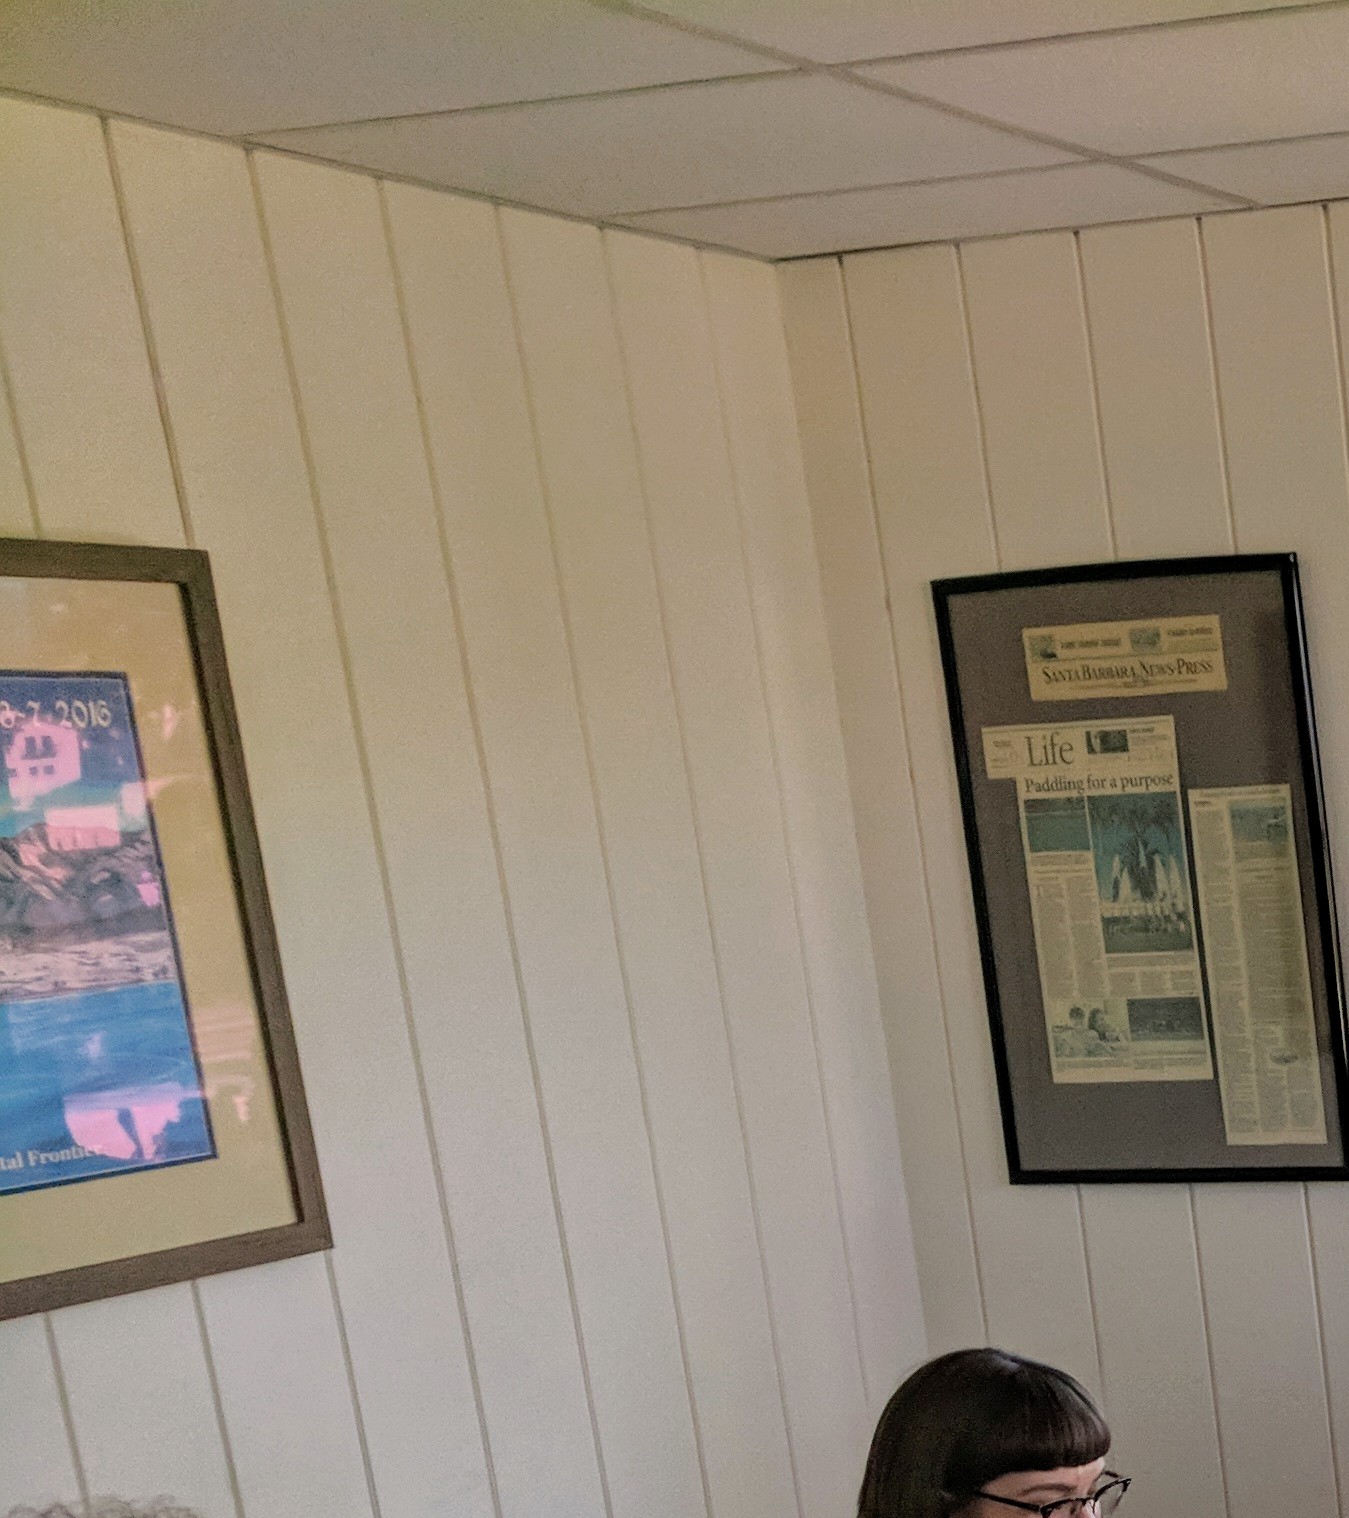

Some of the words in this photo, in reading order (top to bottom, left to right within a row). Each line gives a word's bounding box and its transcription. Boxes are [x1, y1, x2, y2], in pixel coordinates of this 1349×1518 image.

[1041, 664, 1079, 683] SANTA
[1080, 663, 1137, 682] BARBARA
[1024, 731, 1075, 767] Life
[1025, 775, 1085, 796] Paddling
[1086, 774, 1107, 791] for
[1109, 778, 1118, 789] a
[1121, 773, 1174, 792] purpose
